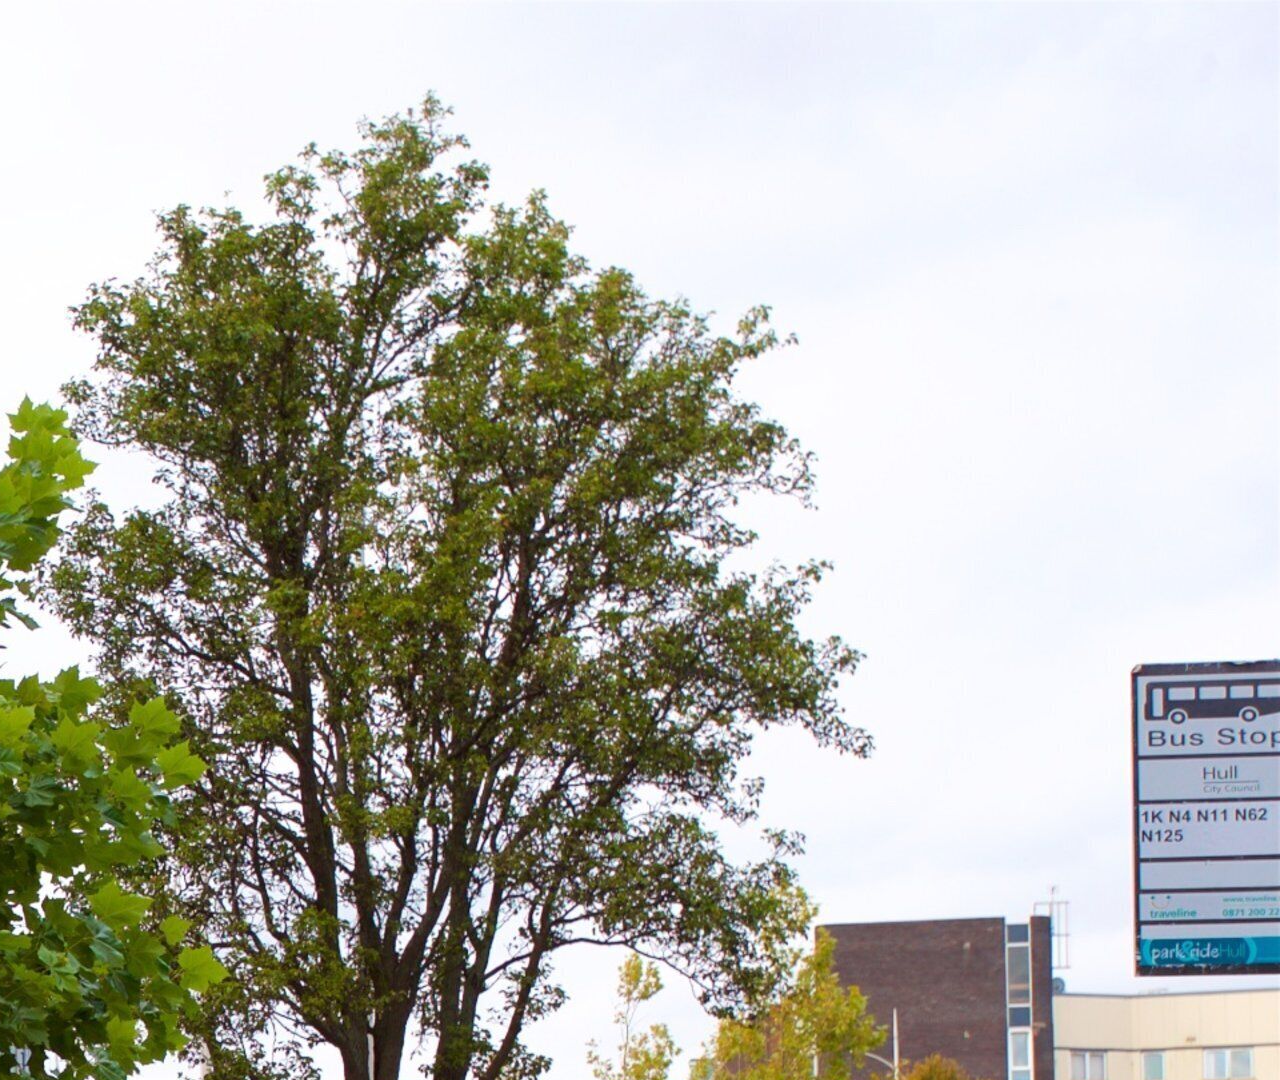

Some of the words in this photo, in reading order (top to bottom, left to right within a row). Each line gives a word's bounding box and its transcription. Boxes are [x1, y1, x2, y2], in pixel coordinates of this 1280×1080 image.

[1148, 730, 1204, 747] Bus
[1203, 765, 1237, 779] Hull
[1203, 785, 1221, 794] City
[1224, 784, 1260, 793] Council
[1141, 811, 1162, 823] 1K
[1169, 810, 1191, 822] N4
[1197, 809, 1228, 822] N11
[1235, 808, 1267, 821] N62
[1141, 829, 1183, 842] N125
[1150, 908, 1197, 918] traveline
[1248, 908, 1266, 916] 200
